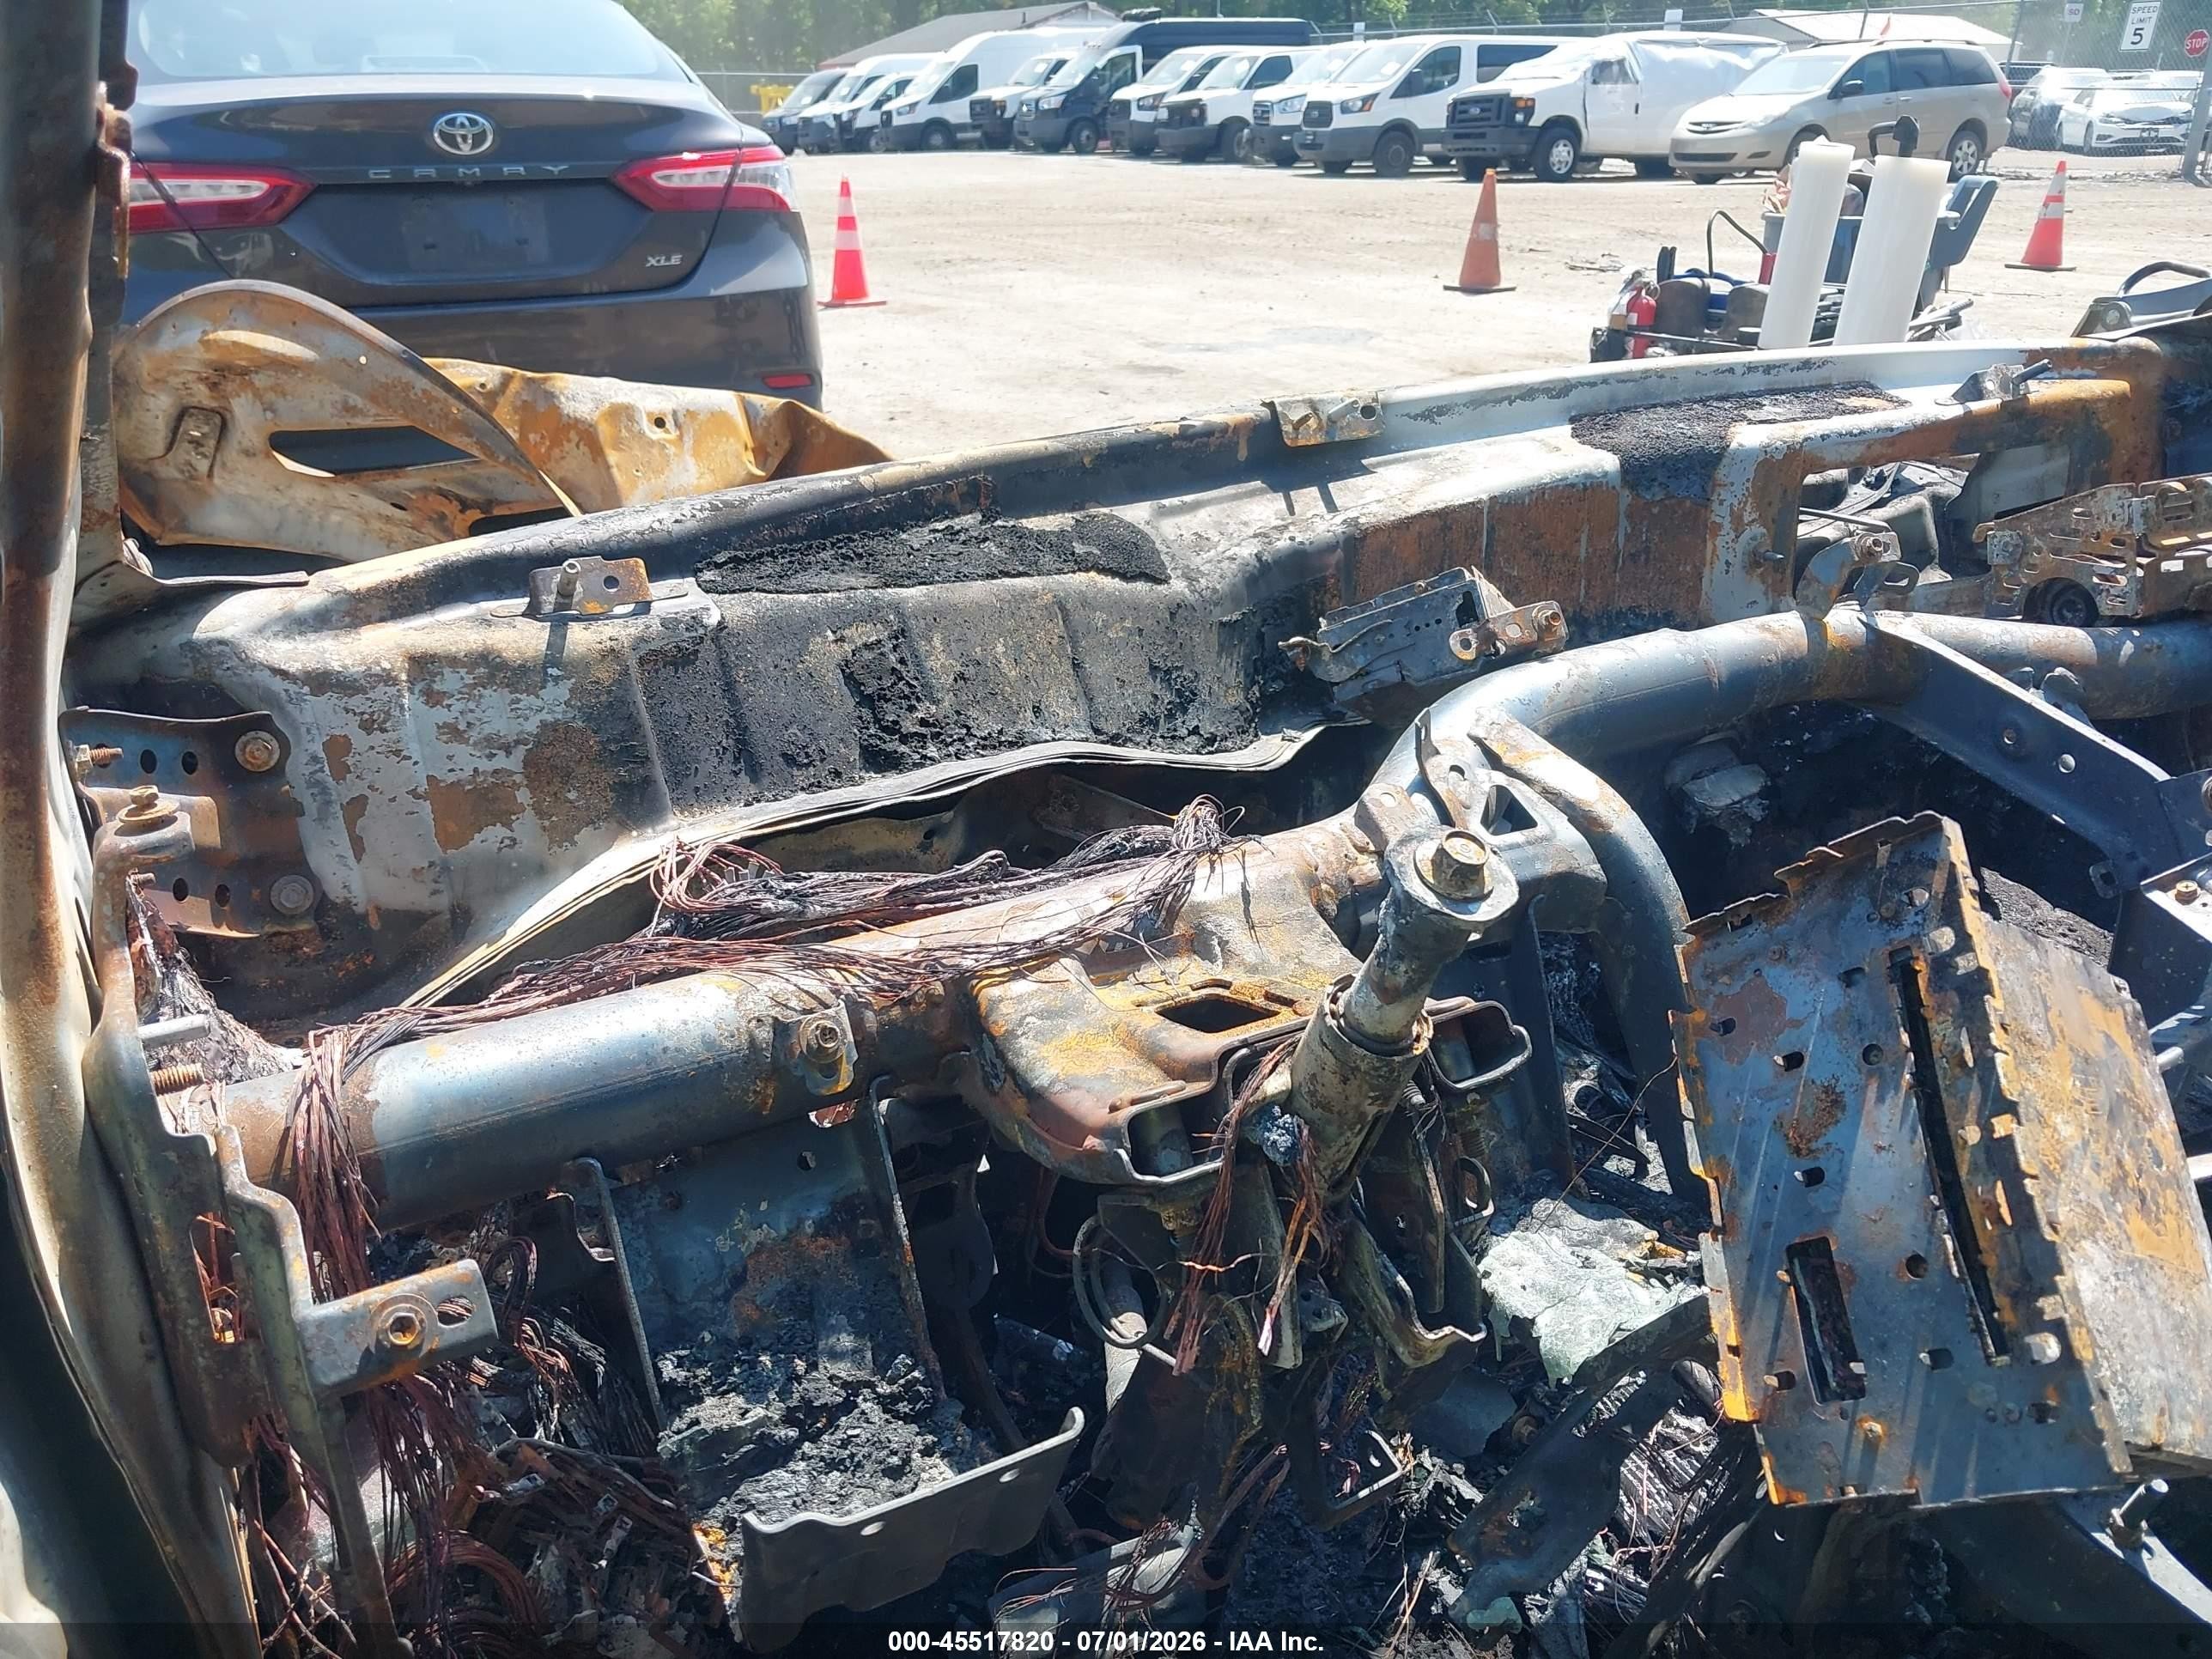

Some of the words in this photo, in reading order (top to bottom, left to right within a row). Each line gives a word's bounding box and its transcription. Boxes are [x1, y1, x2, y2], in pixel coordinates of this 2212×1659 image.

[2131, 5, 2158, 14] SPEED
[2130, 27, 2145, 46] 5
[2185, 38, 2208, 50] STOP
[368, 166, 569, 179] CAMRY
[645, 254, 683, 267] XLE
